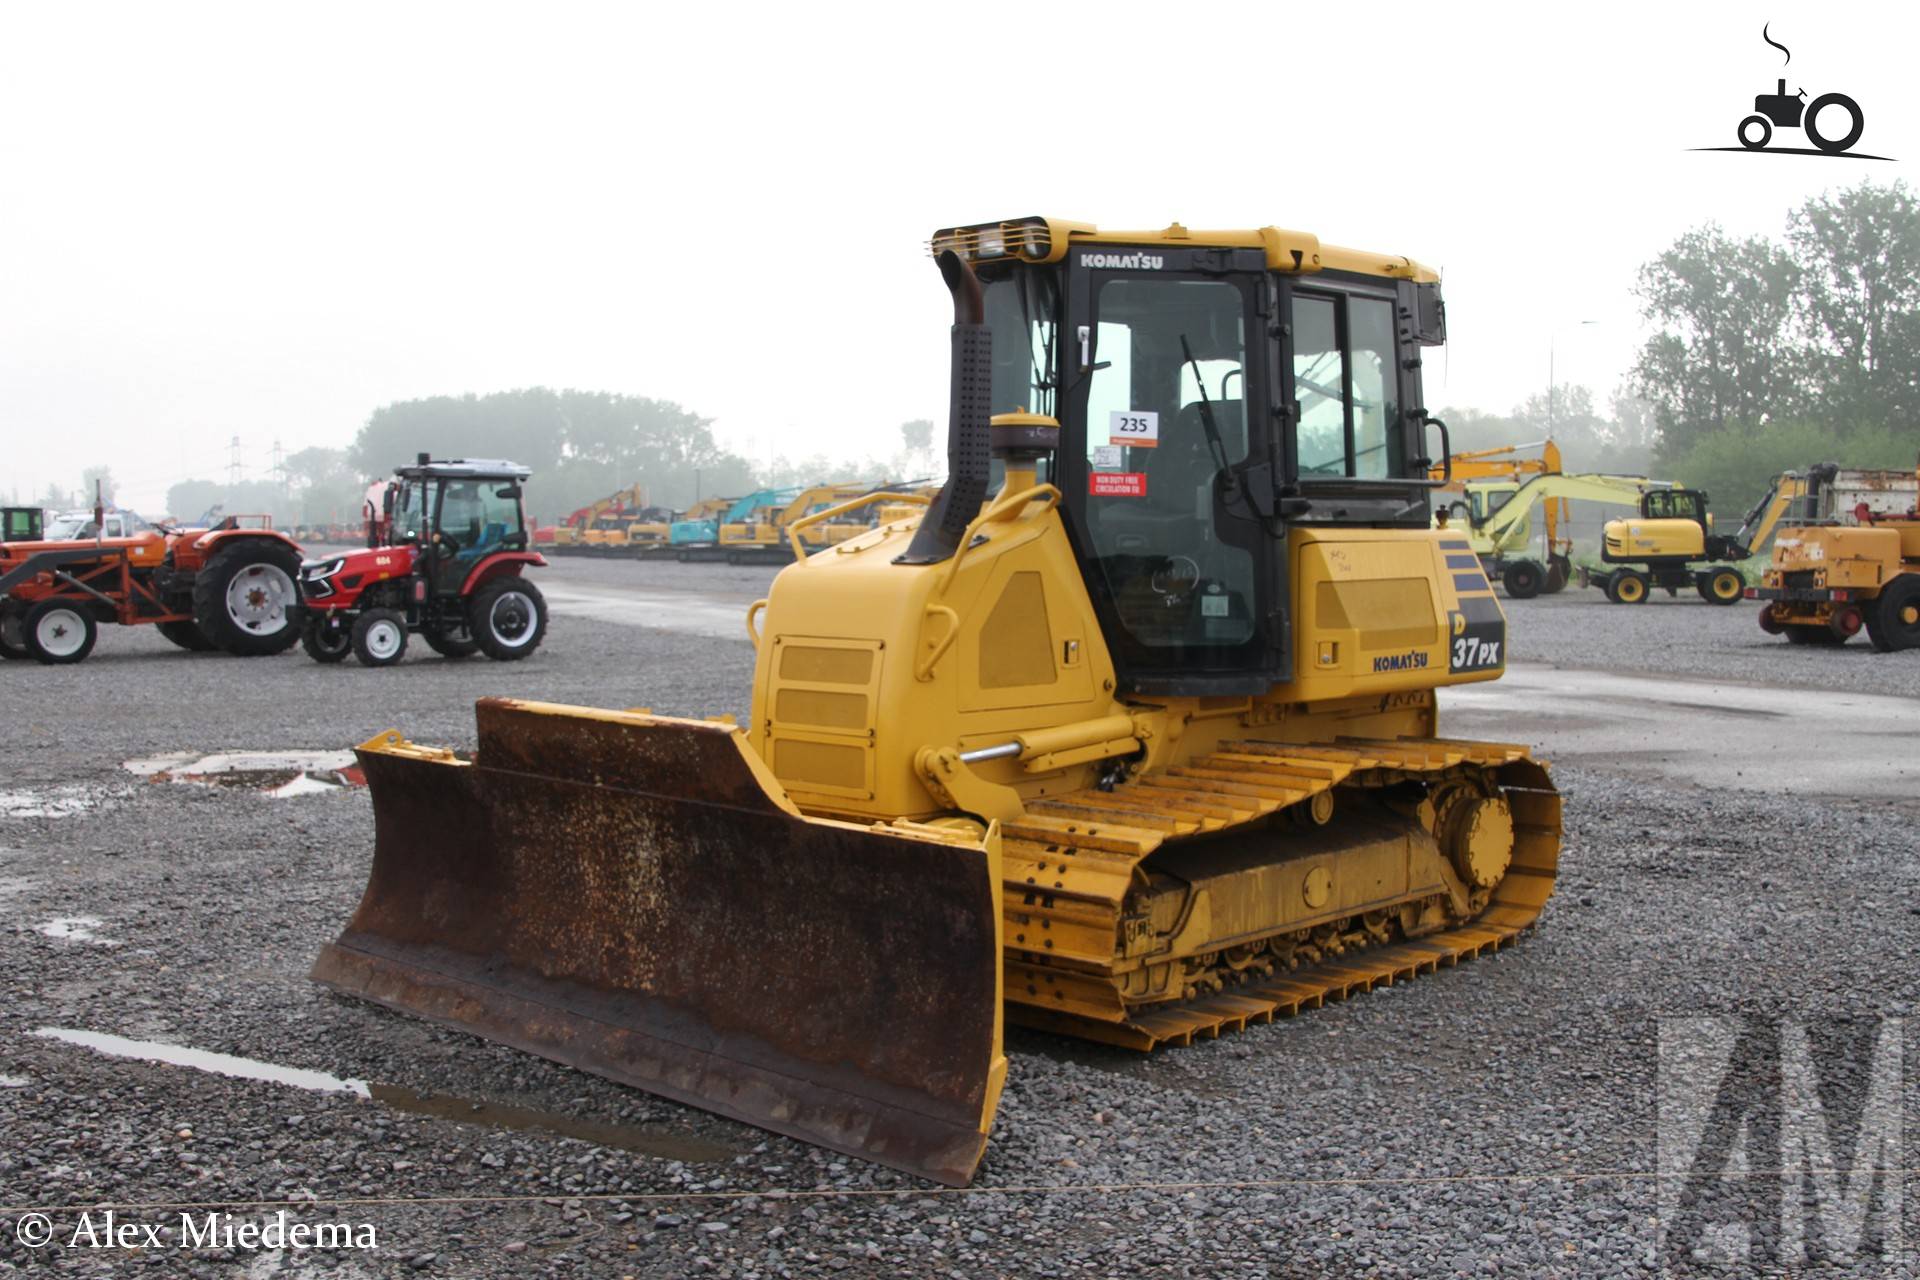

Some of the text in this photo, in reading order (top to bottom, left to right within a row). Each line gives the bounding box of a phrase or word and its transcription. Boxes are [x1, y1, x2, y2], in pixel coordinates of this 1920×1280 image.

[1080, 252, 1163, 270] KOMATSU
[1120, 417, 1148, 433] 235
[1453, 613, 1466, 635] D
[1373, 650, 1428, 672] KOMATSU
